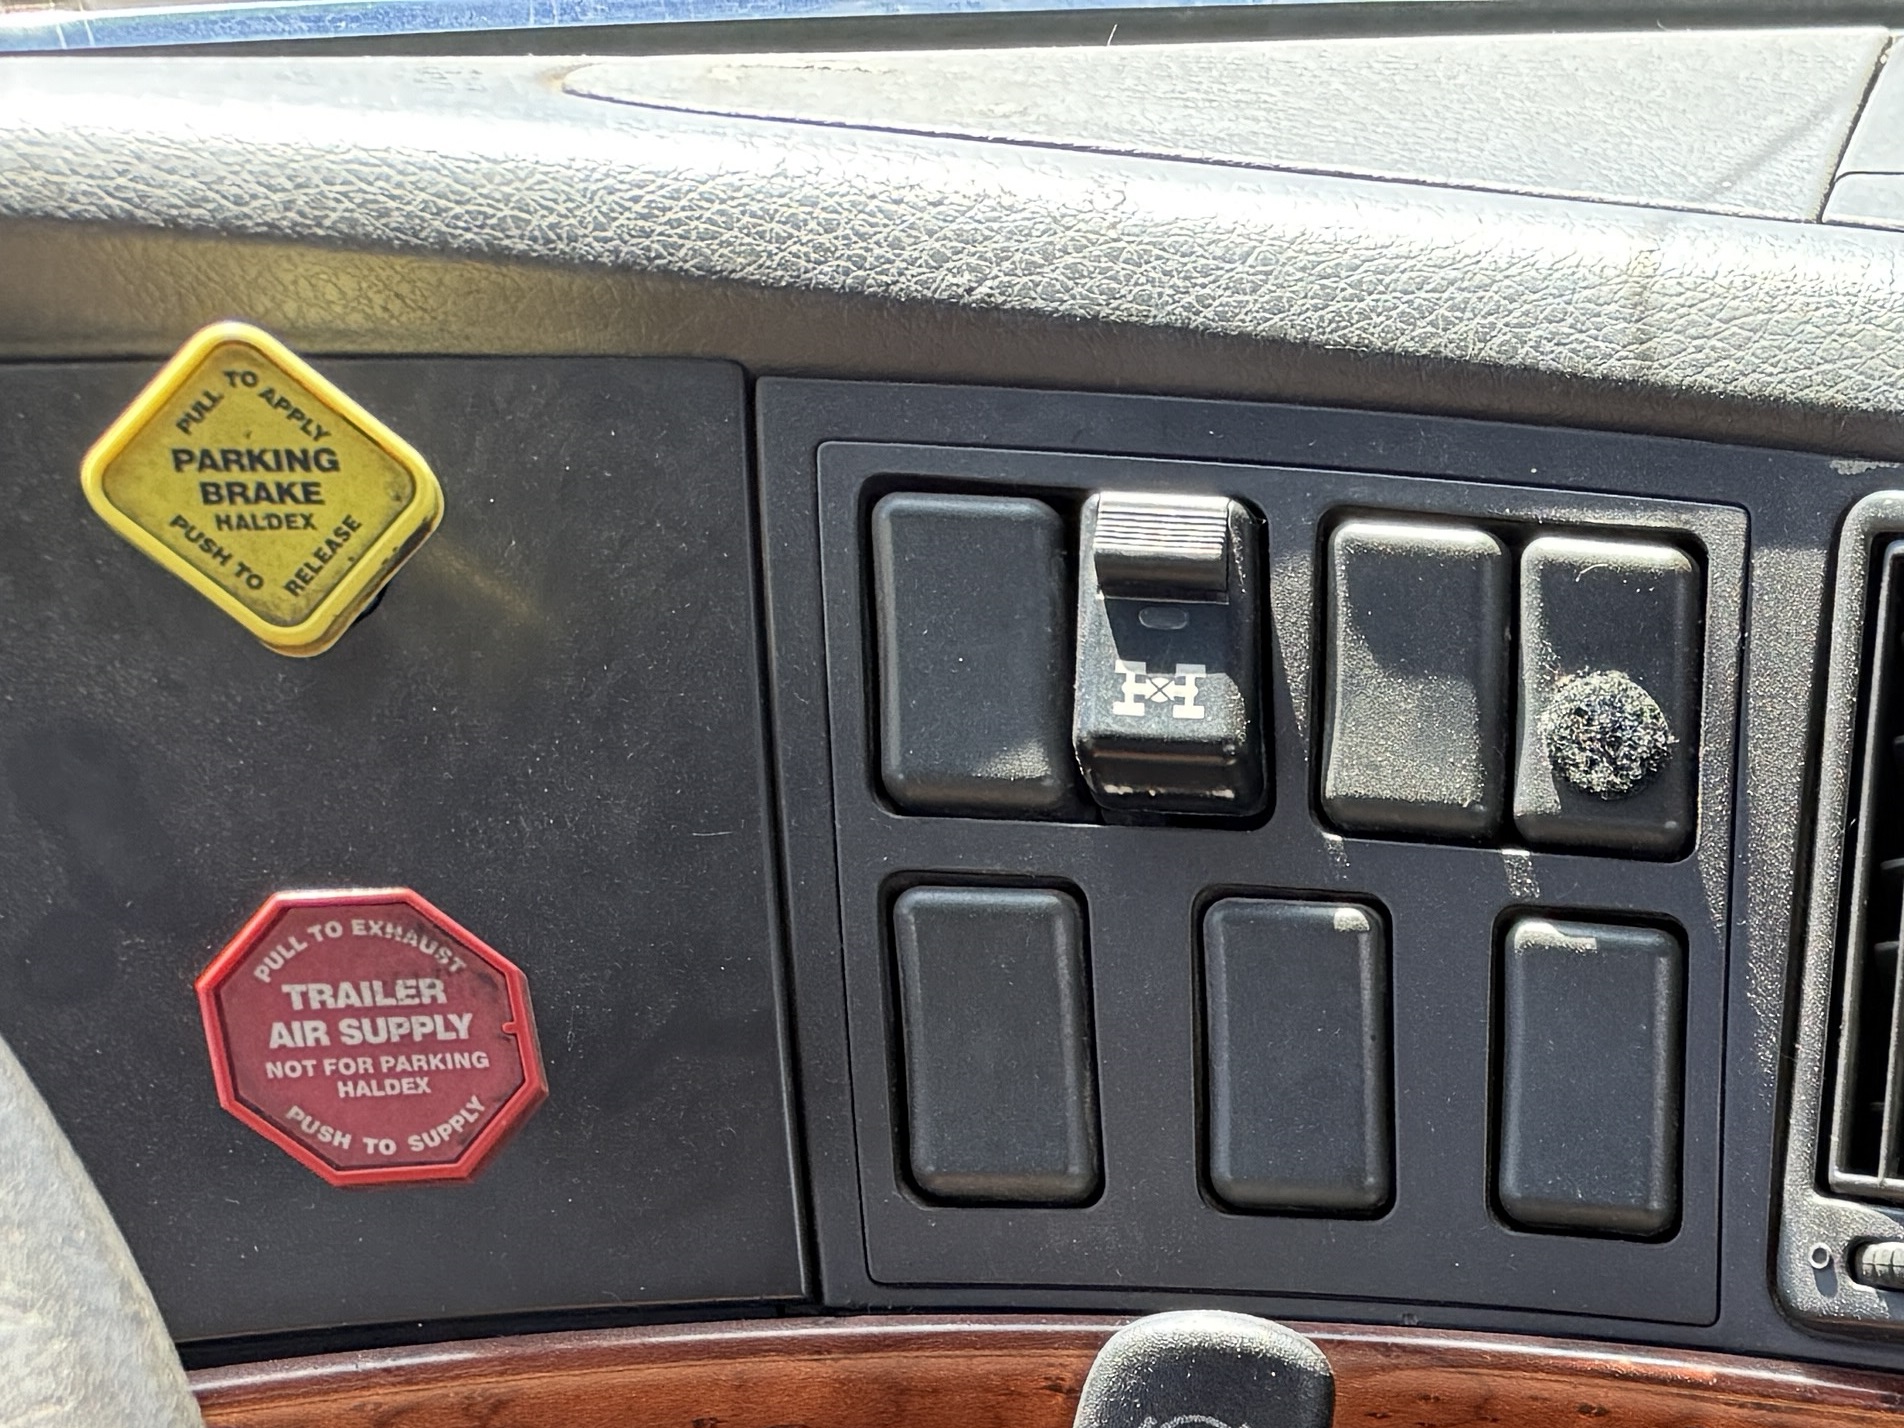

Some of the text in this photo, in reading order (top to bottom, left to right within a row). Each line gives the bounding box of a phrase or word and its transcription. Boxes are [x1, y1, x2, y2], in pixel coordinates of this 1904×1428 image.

[176, 370, 331, 442] PULL TO APPLY
[170, 447, 340, 473] PARKING
[200, 481, 326, 505] BRAKE
[215, 513, 318, 531] HALDEX
[169, 514, 363, 598] PUSH TO RELEASE
[253, 919, 468, 984] PULL TO EXHAUST
[281, 977, 448, 1011] TRAILER
[268, 1012, 474, 1049] AIR SUPPLY
[265, 1051, 490, 1080] NOT FOR PARKING
[336, 1077, 432, 1098] HALDEX
[285, 1095, 486, 1156] PUSH TO SUPPLY
